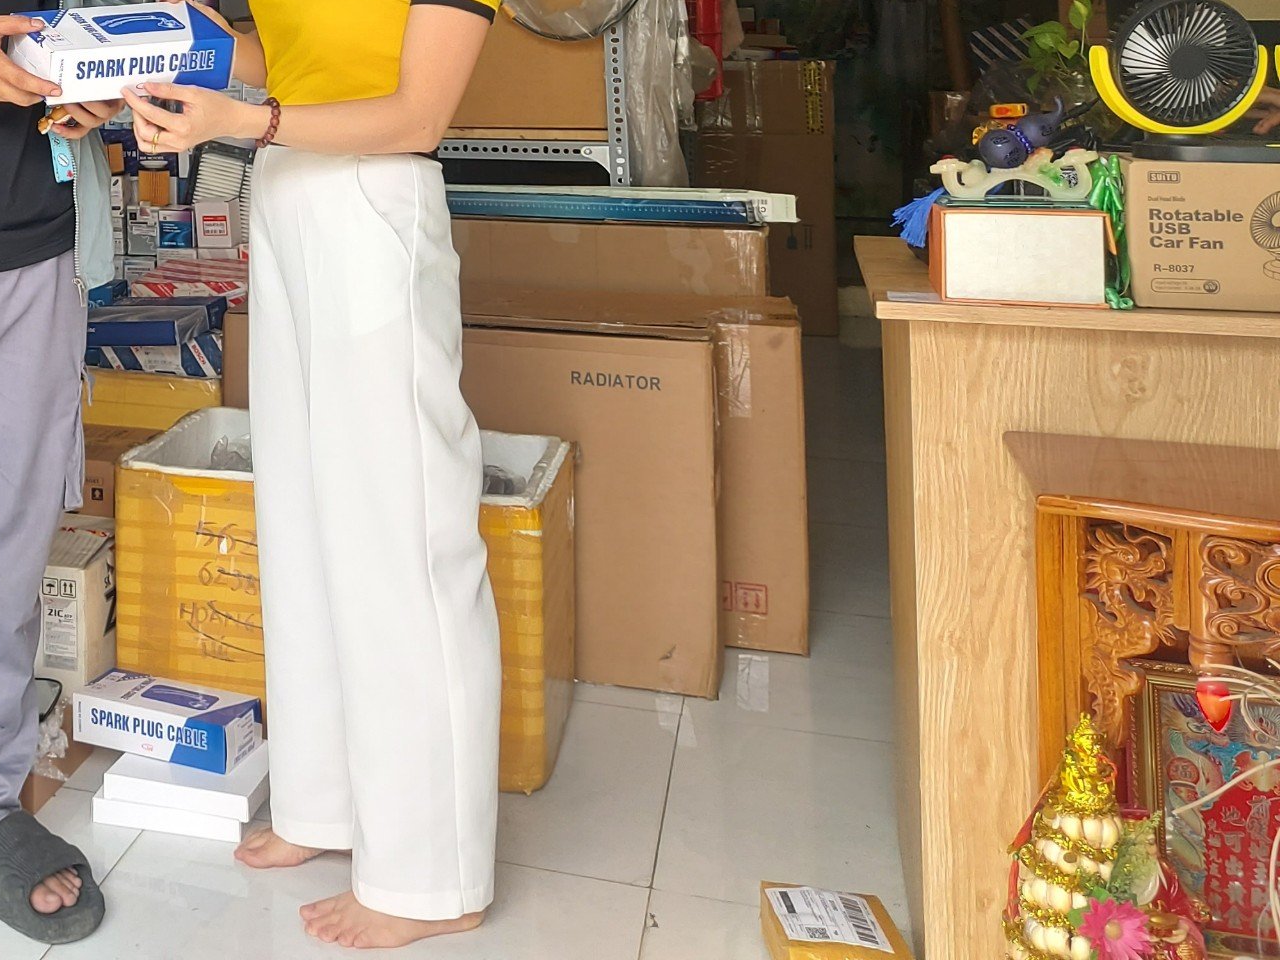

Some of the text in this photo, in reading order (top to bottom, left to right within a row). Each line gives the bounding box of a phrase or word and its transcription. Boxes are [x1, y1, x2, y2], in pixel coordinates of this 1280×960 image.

[76, 49, 216, 80] SPARK PLUG CABLE
[1149, 208, 1244, 222] Rotatable
[1149, 222, 1191, 235] USB
[1149, 236, 1224, 250] Car Fan
[1154, 263, 1195, 274] R-8037
[571, 371, 661, 391] RADIATOR
[47, 608, 64, 618] ZIC
[91, 707, 208, 750] SPARK PLUG CABLE
